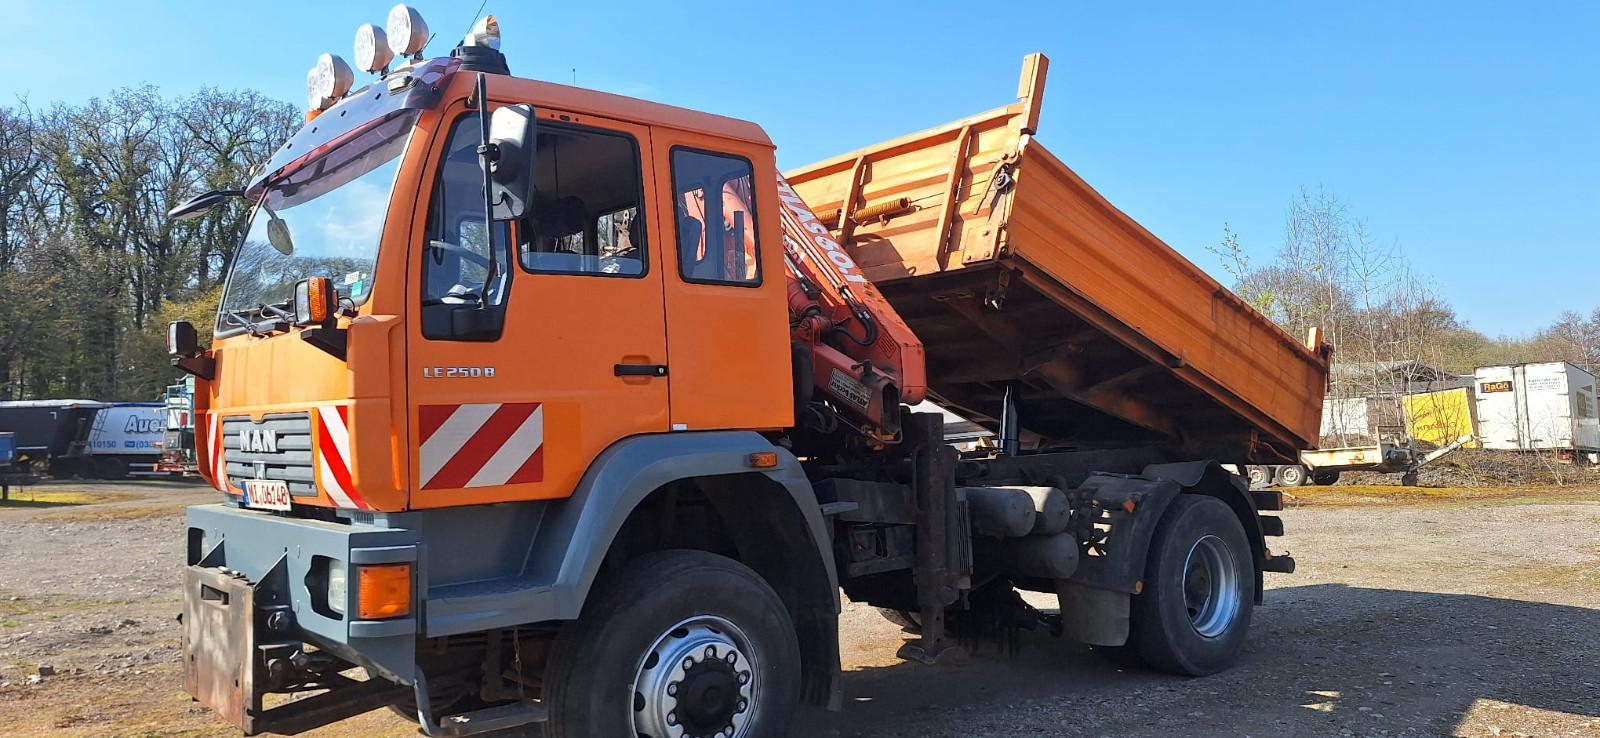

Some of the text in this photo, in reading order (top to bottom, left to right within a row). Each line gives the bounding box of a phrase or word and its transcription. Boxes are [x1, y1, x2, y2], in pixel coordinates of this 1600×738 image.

[423, 367, 495, 378] LE 250 B
[240, 429, 277, 452] MAN
